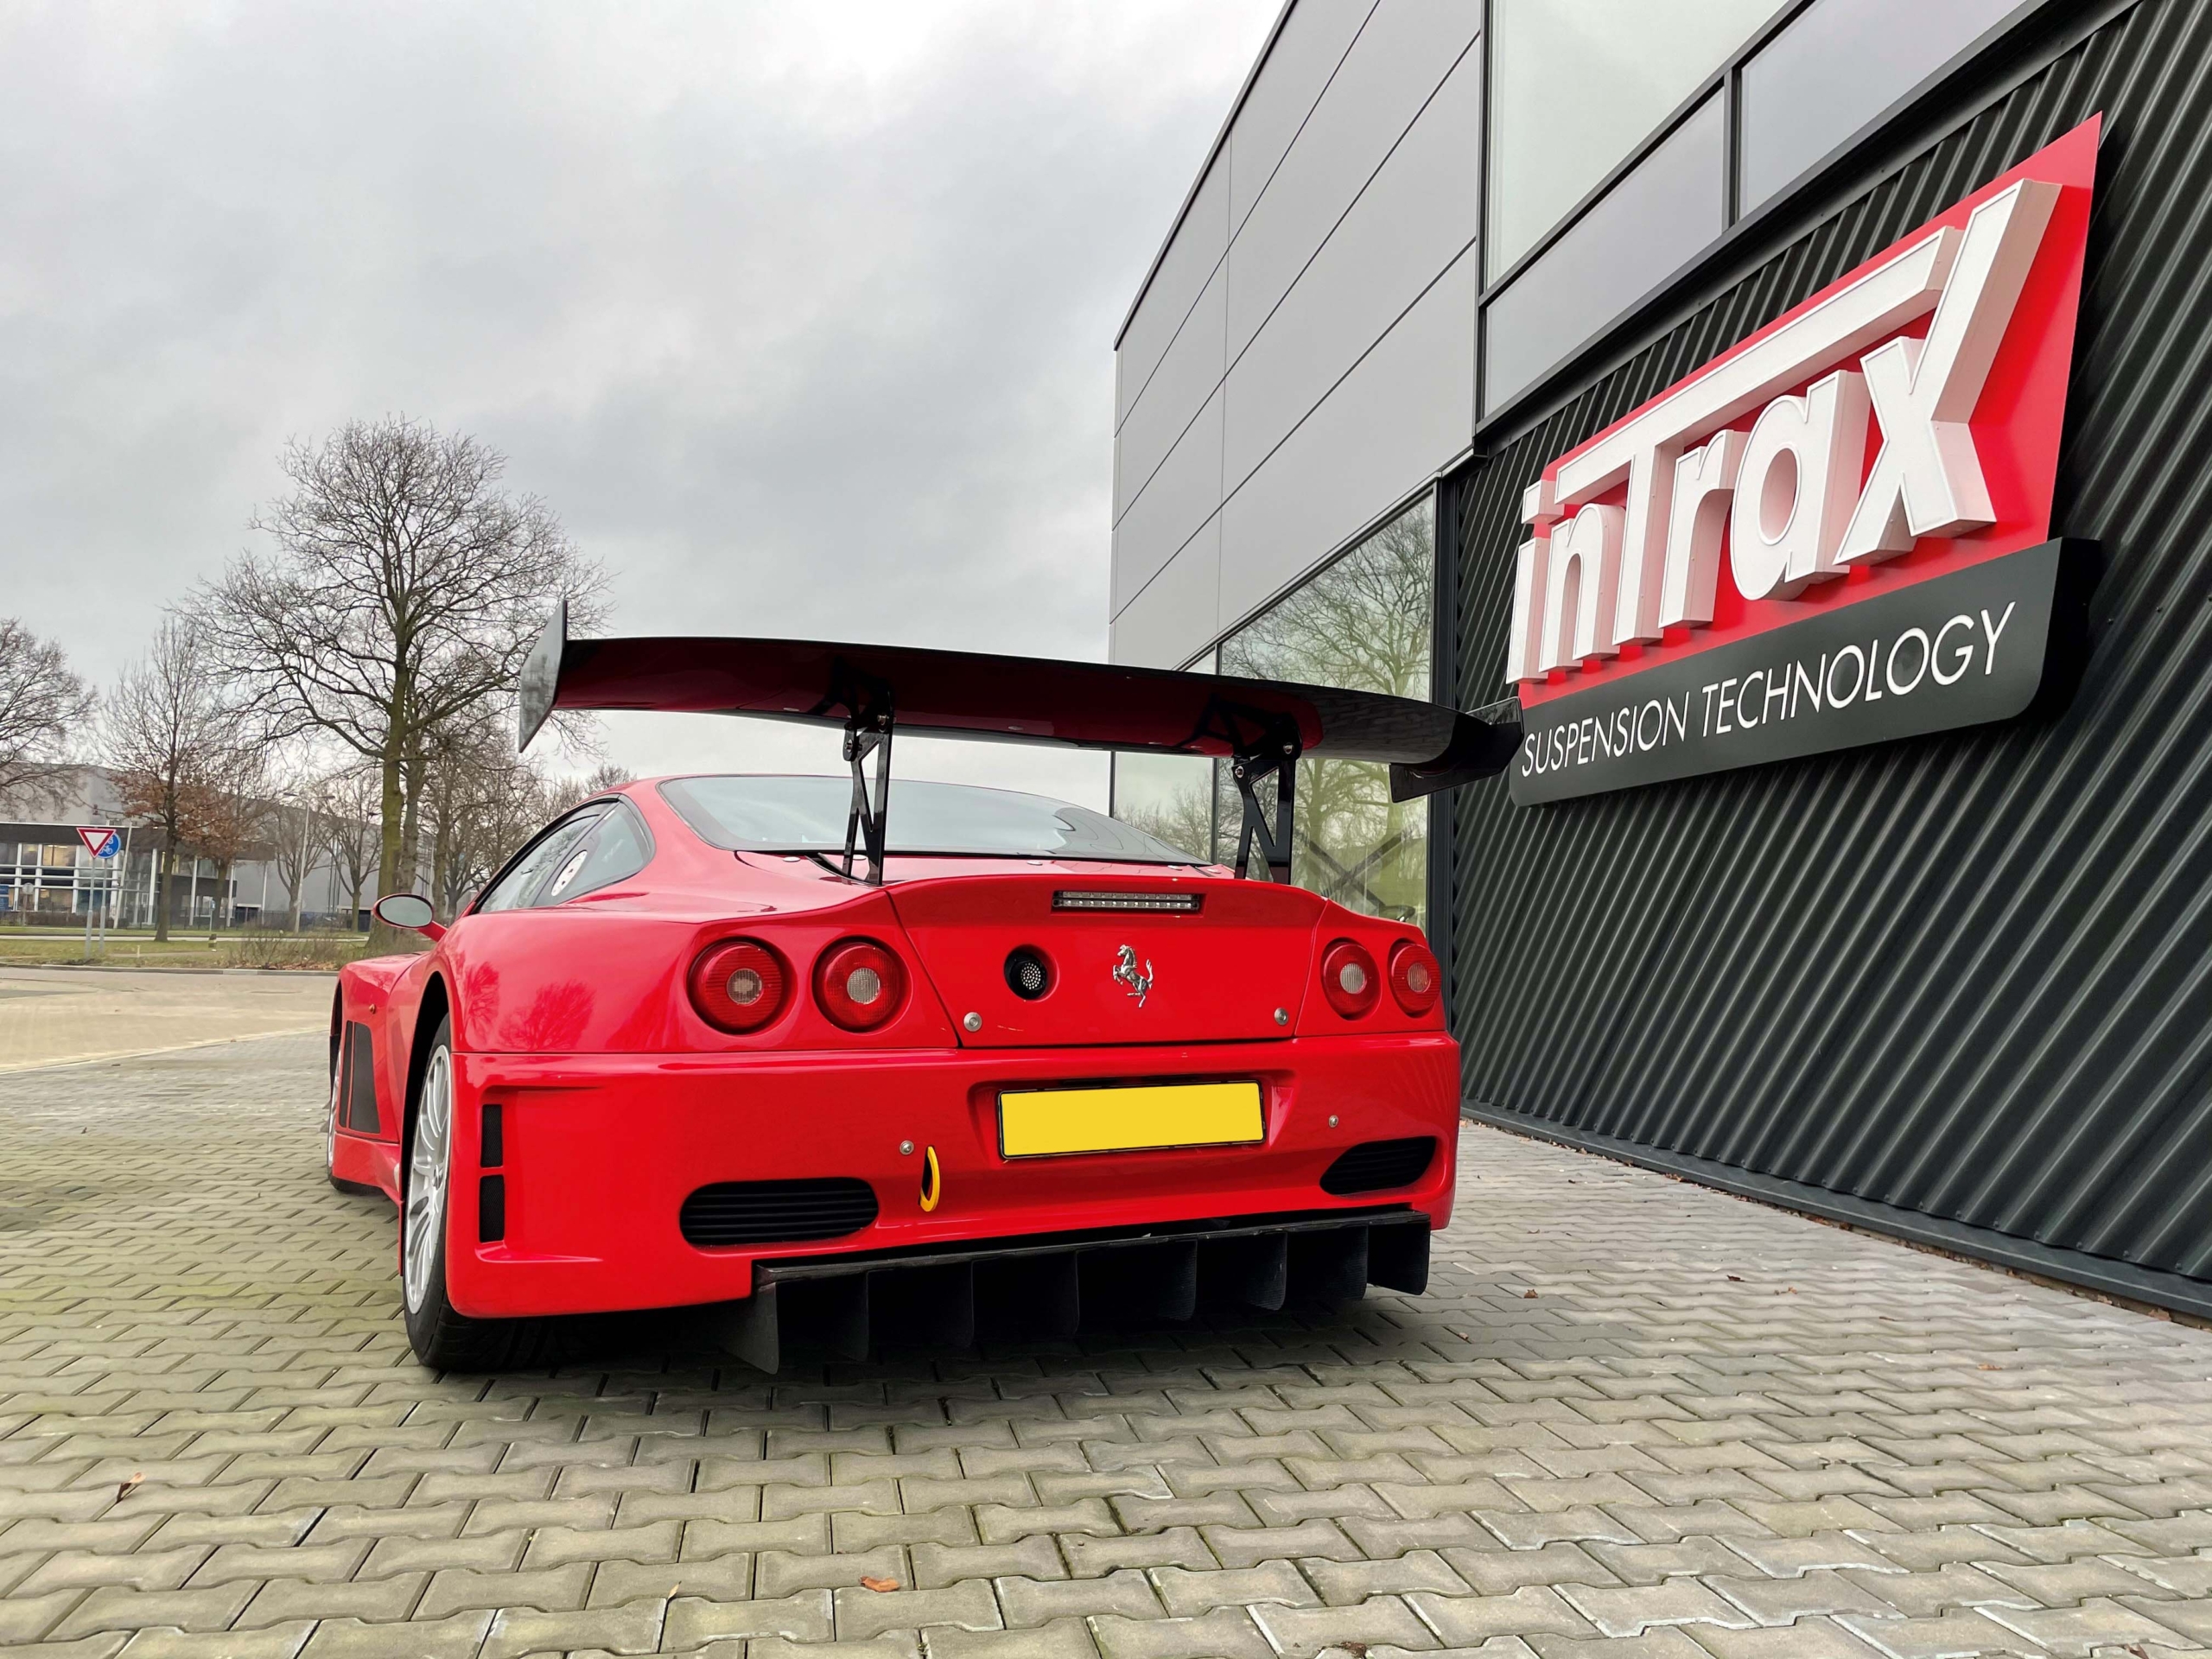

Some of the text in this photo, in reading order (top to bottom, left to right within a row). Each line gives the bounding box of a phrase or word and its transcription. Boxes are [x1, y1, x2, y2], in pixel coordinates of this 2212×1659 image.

[1506, 179, 2061, 683] inTrax
[1522, 601, 2017, 778] SUSPENSION TECHNOLOGY
